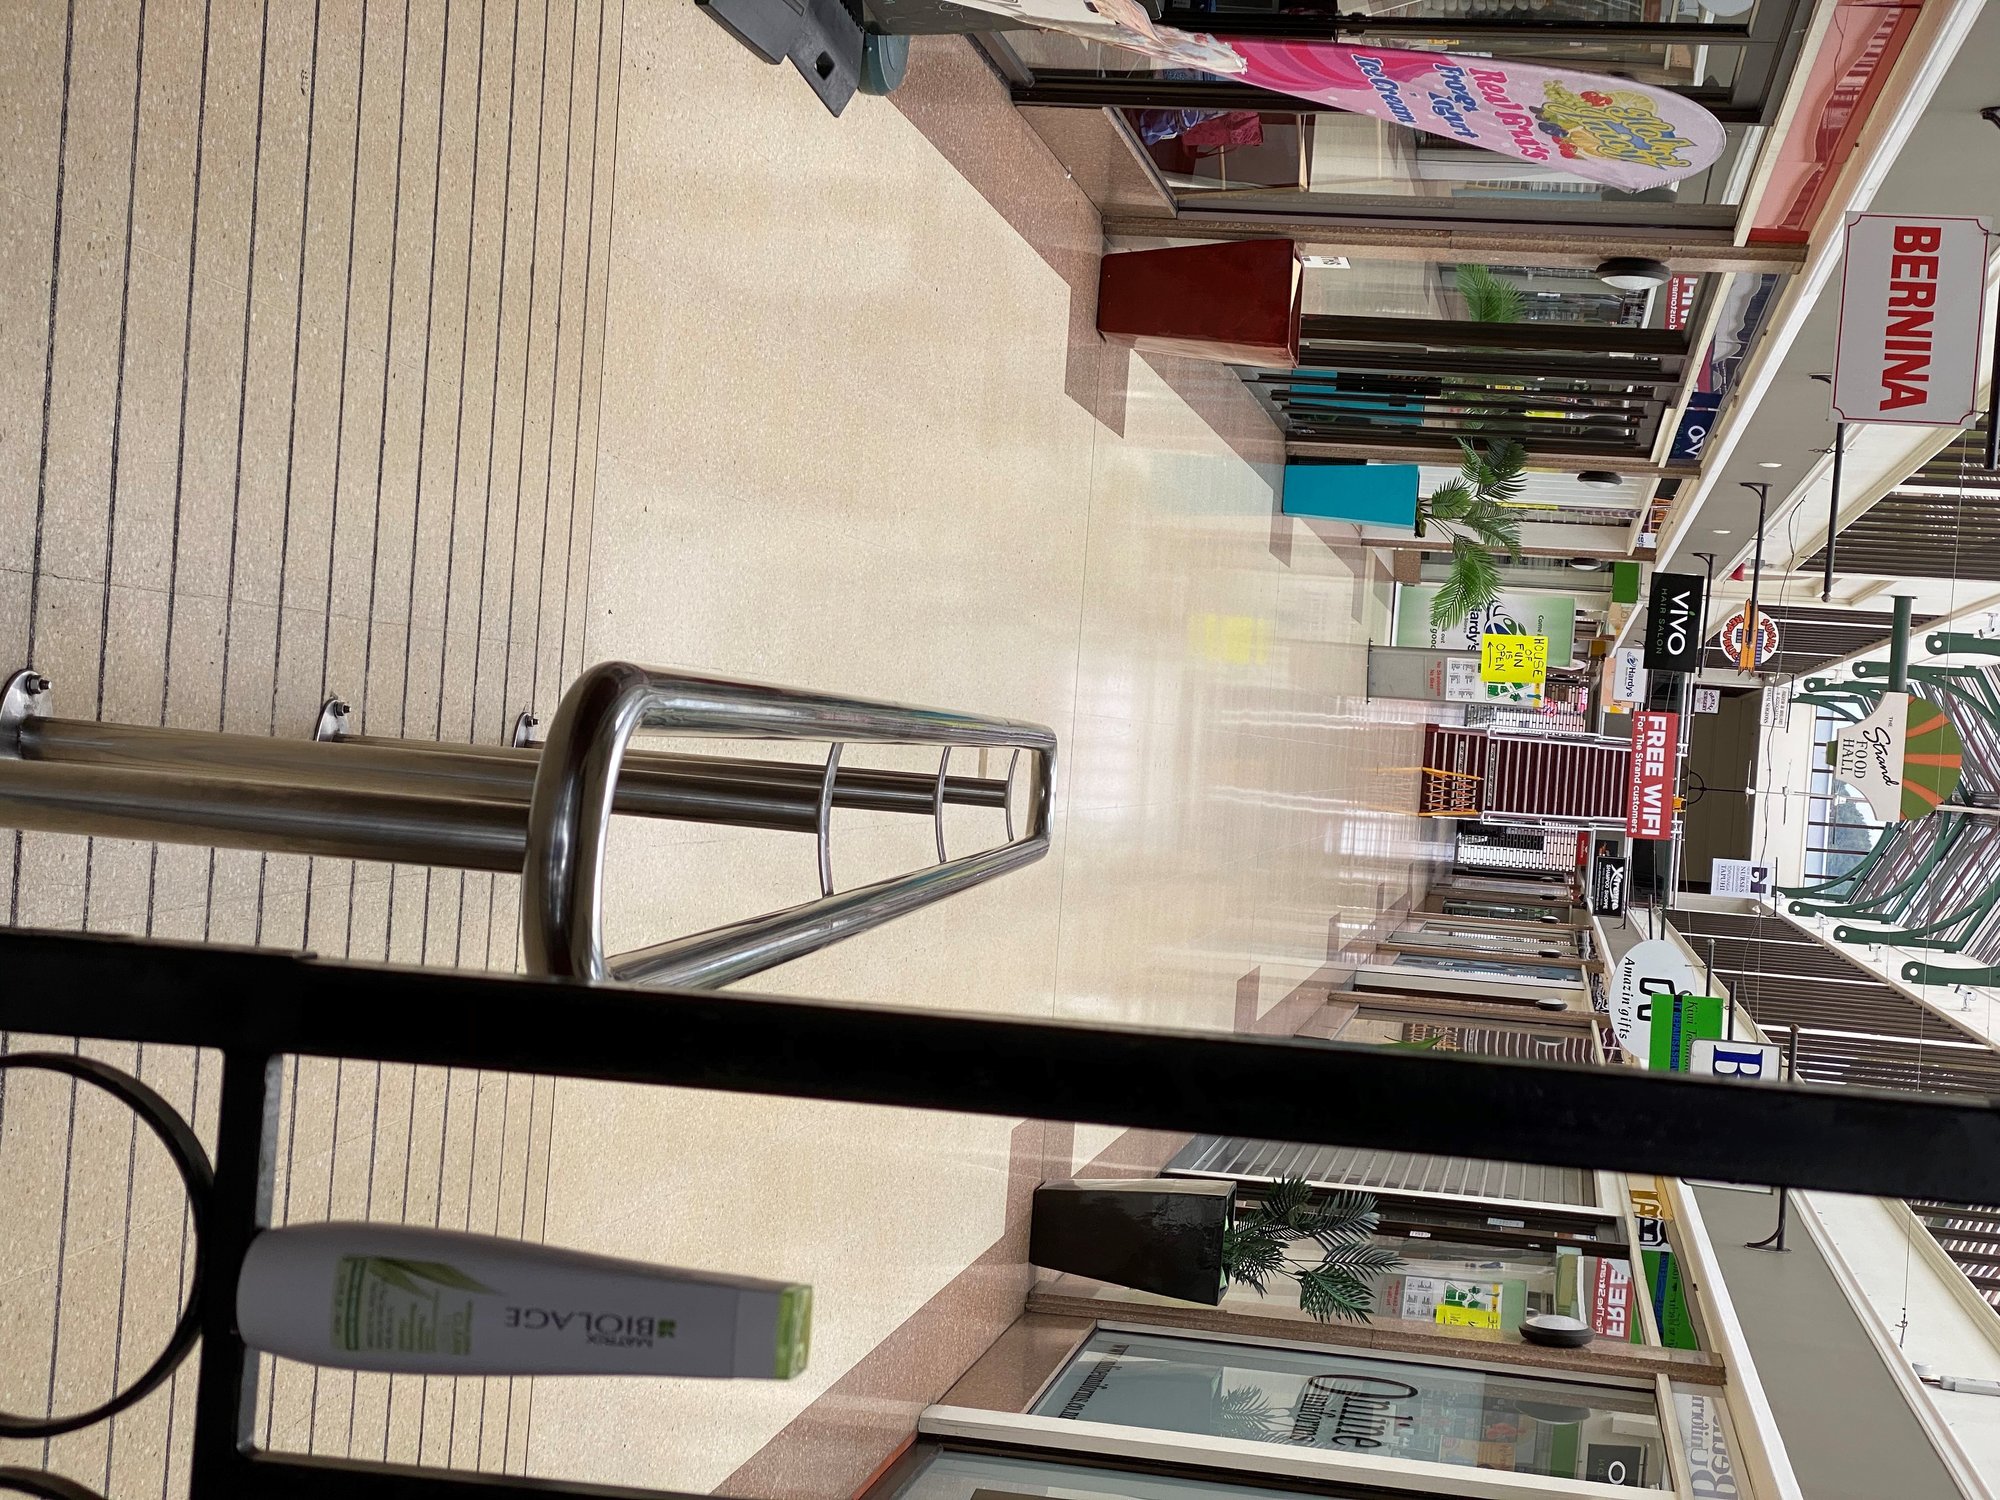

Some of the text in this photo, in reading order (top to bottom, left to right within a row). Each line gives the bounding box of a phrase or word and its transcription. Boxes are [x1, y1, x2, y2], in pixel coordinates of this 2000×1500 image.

[1368, 78, 1418, 124] Cream
[1468, 67, 1525, 111] Real
[1879, 226, 1942, 411] BERNINA
[1655, 588, 1668, 654] HAIR SALON
[1722, 614, 1745, 660] REPUBLIC
[1760, 618, 1777, 654] SUSHI
[1494, 643, 1506, 672] OPEN
[1506, 651, 1513, 660] IS
[1514, 644, 1525, 668] FUN
[1524, 650, 1532, 662] OF
[1532, 638, 1545, 678] HOUSE
[1626, 667, 1636, 698] Hardy's
[1630, 716, 1646, 833] For The Strand customers
[1841, 739, 1855, 774] HALL
[1854, 741, 1868, 778] FOOD
[1863, 727, 1899, 786] Strand
[1641, 716, 1667, 836] FREE WIFI
[1672, 1001, 1682, 1009] IT
[1684, 1001, 1699, 1024] Kiwi
[503, 1307, 656, 1338] BIOLAGE
[1289, 1393, 1337, 1444] uniforms
[1308, 1374, 1418, 1448] Online
